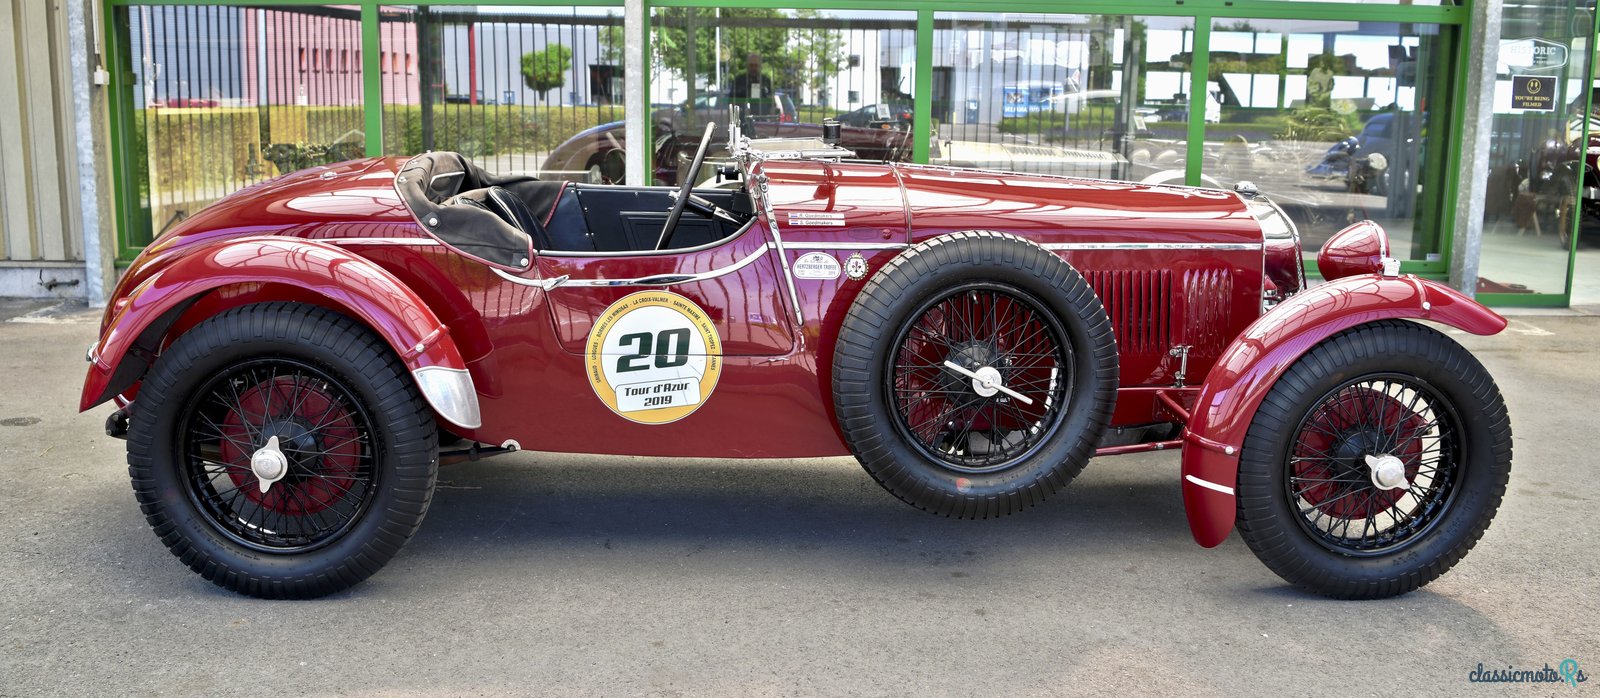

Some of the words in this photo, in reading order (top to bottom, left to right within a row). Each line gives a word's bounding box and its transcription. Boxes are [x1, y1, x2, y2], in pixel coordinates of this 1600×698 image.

[1511, 46, 1556, 55] HISTORIC
[612, 304, 628, 317] MIMOSAS
[673, 300, 688, 310] SAINTE
[686, 307, 700, 321] MAXIME
[701, 322, 710, 335] SAINT
[616, 328, 691, 373] 20
[624, 386, 652, 397] Tour
[653, 382, 690, 394] d'Azur
[644, 395, 672, 407] 2019
